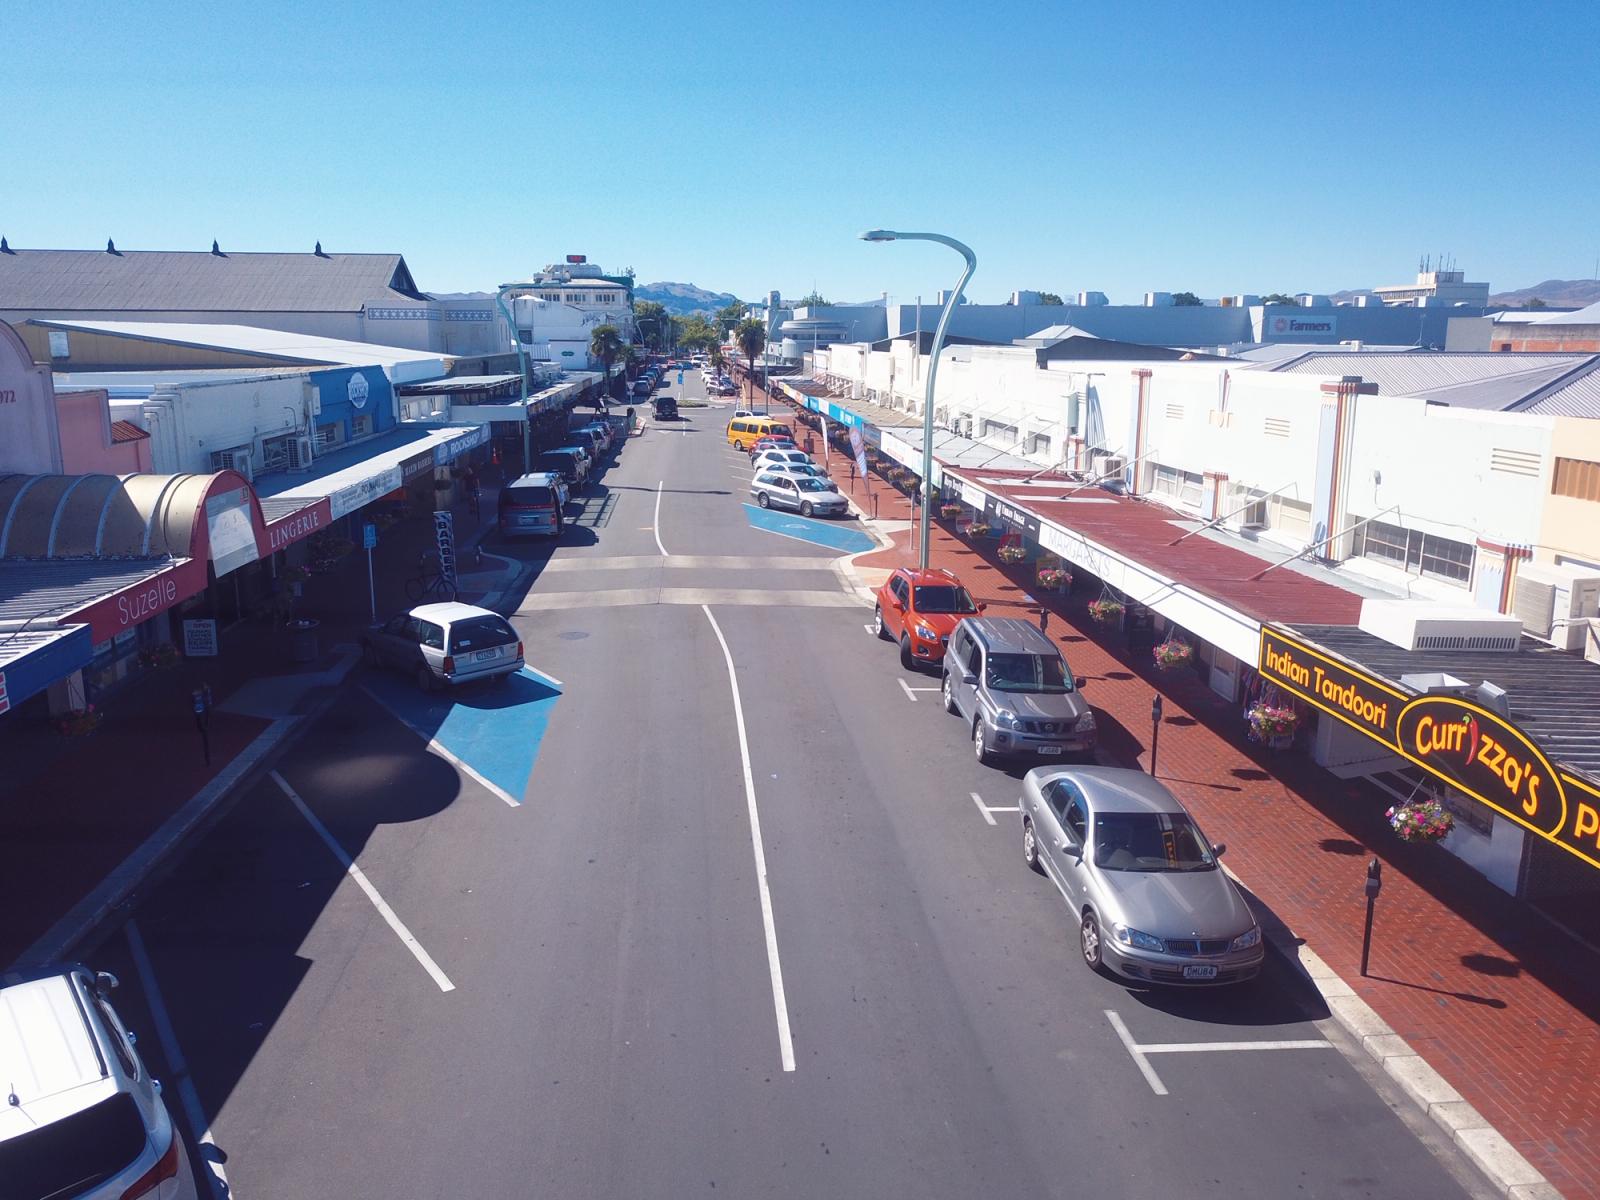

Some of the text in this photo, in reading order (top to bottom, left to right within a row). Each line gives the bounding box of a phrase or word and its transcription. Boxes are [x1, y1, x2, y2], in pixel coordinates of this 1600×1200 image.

[1290, 319, 1331, 331] Farmers
[451, 433, 480, 454] ROCKSHOP
[270, 511, 319, 549] LINGERIE
[118, 579, 177, 624] Suzelle
[1266, 643, 1388, 729] Indian Tandoori
